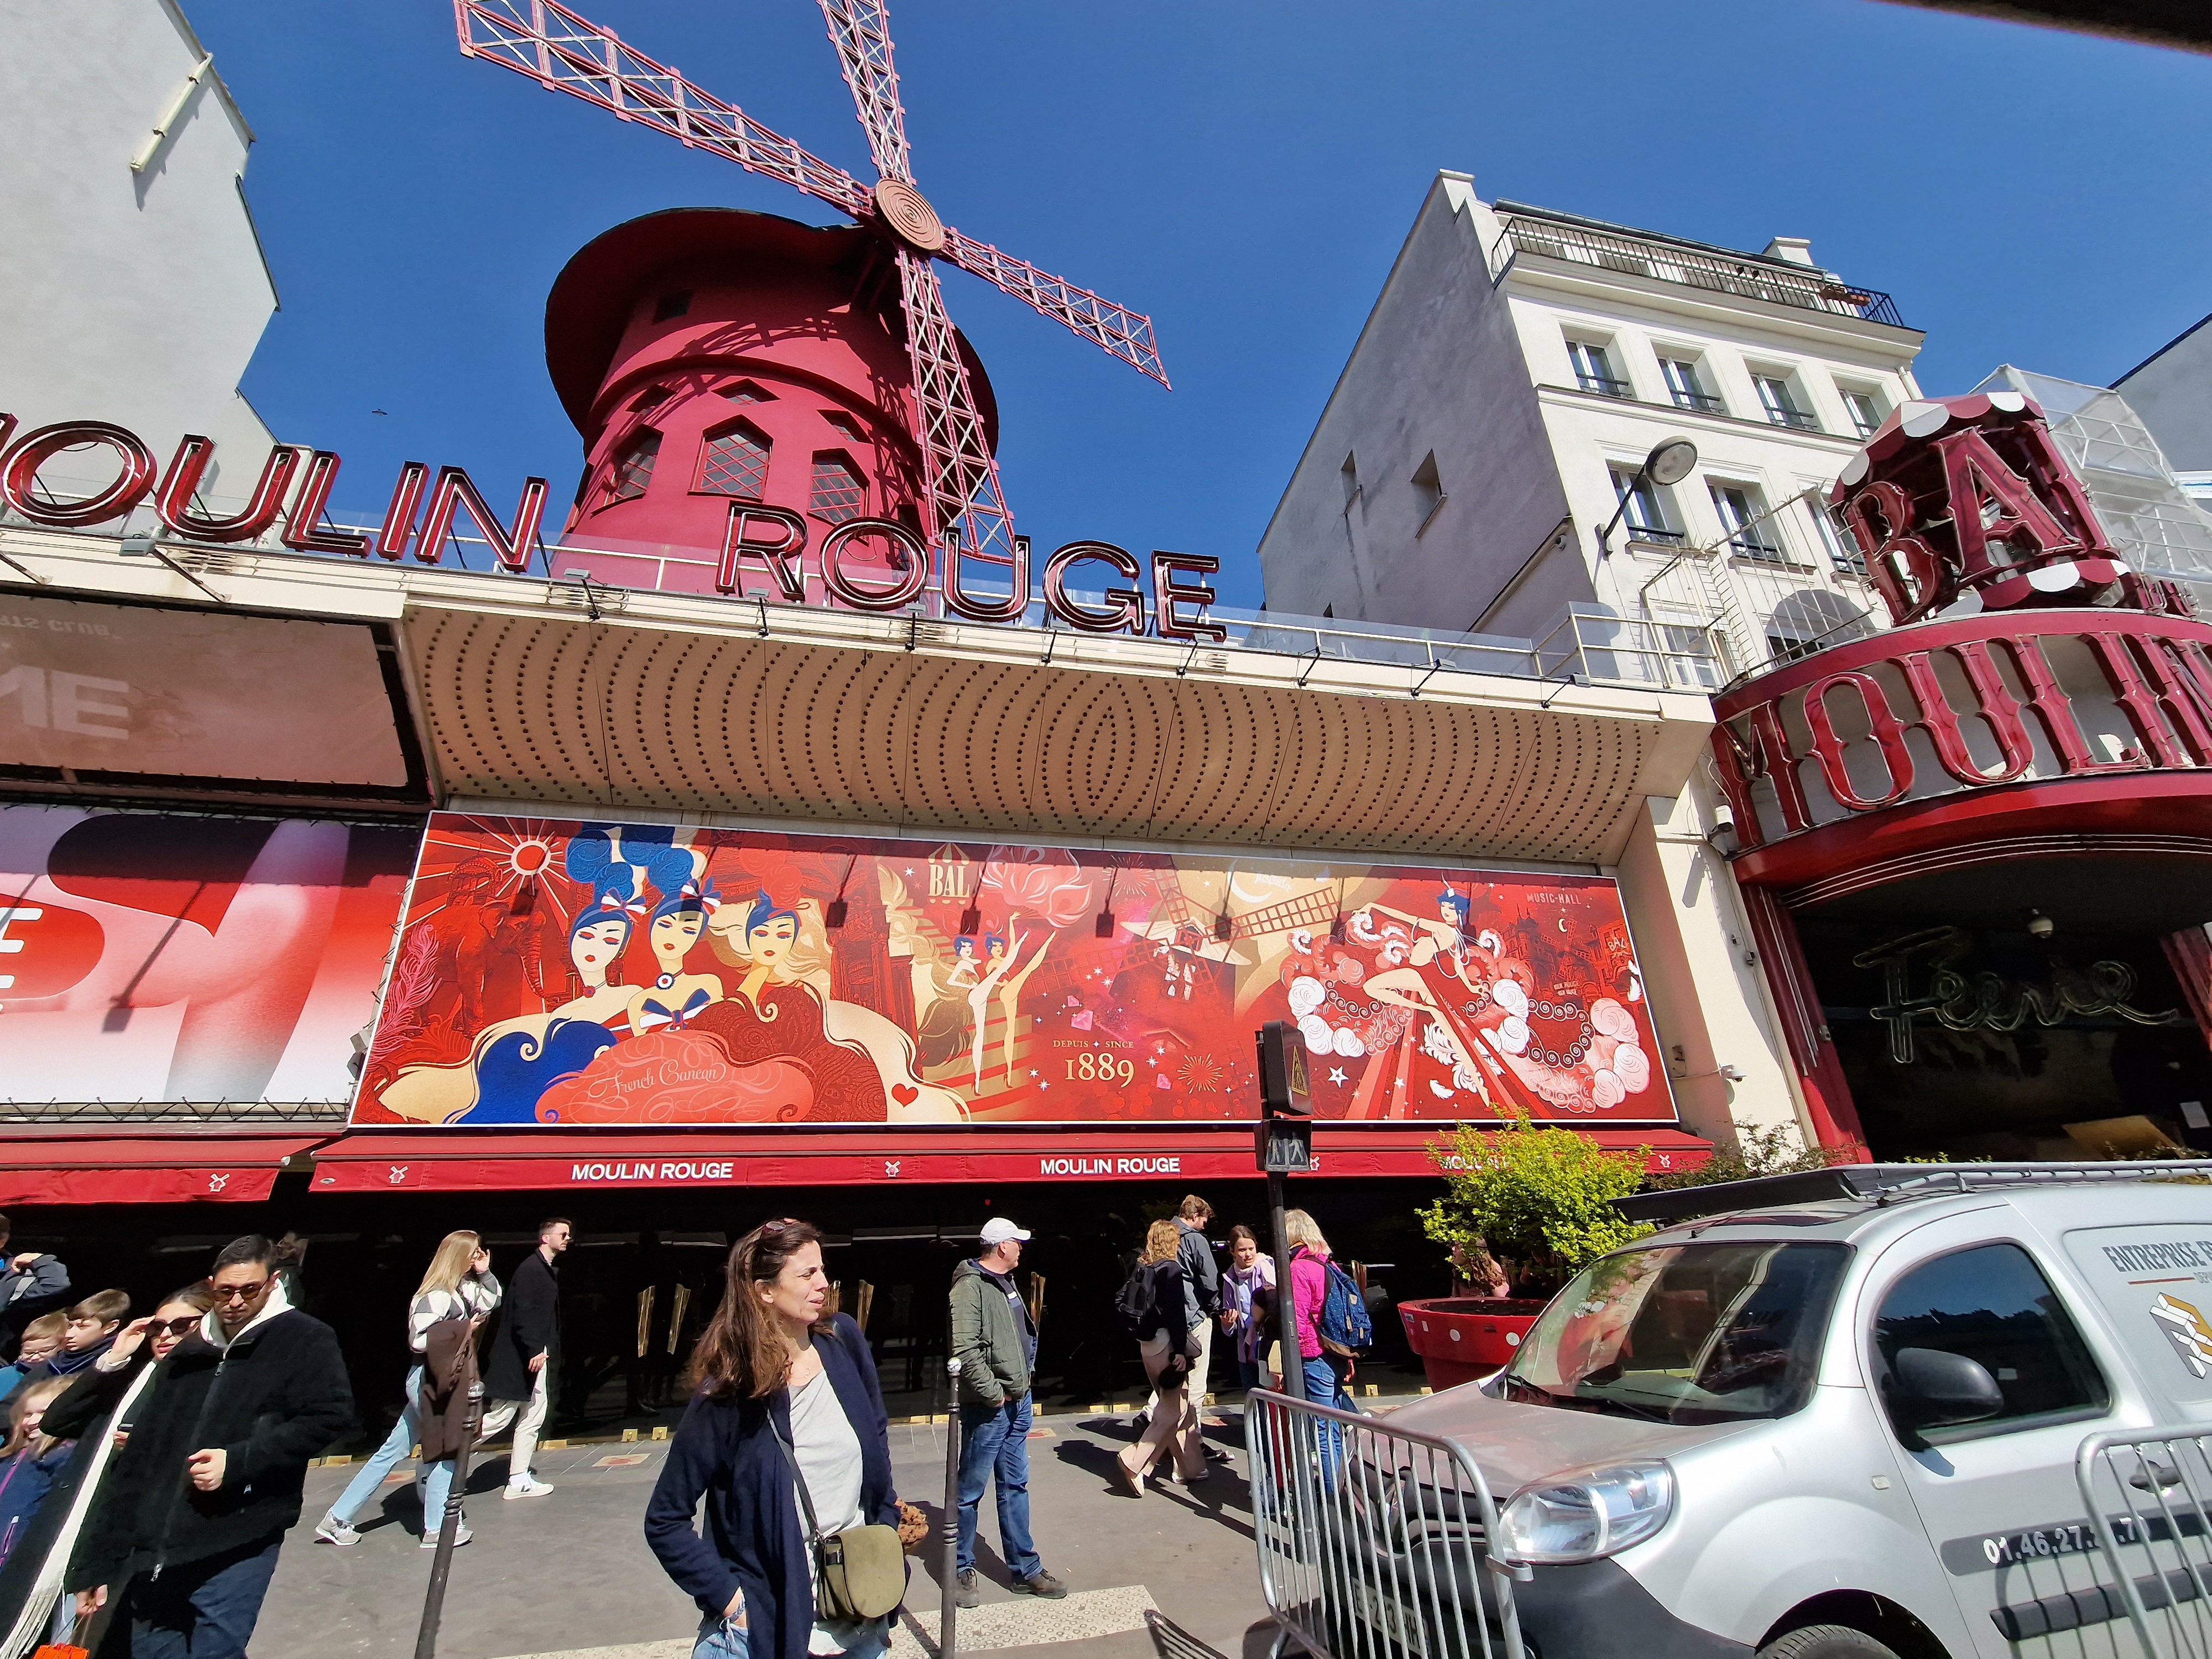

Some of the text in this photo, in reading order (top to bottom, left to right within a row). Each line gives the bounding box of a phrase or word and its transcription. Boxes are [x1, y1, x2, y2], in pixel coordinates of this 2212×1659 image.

[0, 412, 1227, 643] OULIN ROUGE
[928, 864, 970, 898] BAL
[1526, 893, 1582, 905] MUSIC-HALL
[1608, 937, 1627, 952] BAL
[1053, 1040, 1134, 1048] DEPUIS SINCE
[588, 1059, 726, 1104] French Cancan
[1065, 1052, 1134, 1088] 1889
[572, 1162, 734, 1180] MOULIN ROUGE
[1040, 1157, 1181, 1175] MOULIN ROUGE
[2102, 1241, 2207, 1272] ENTREPRISE
